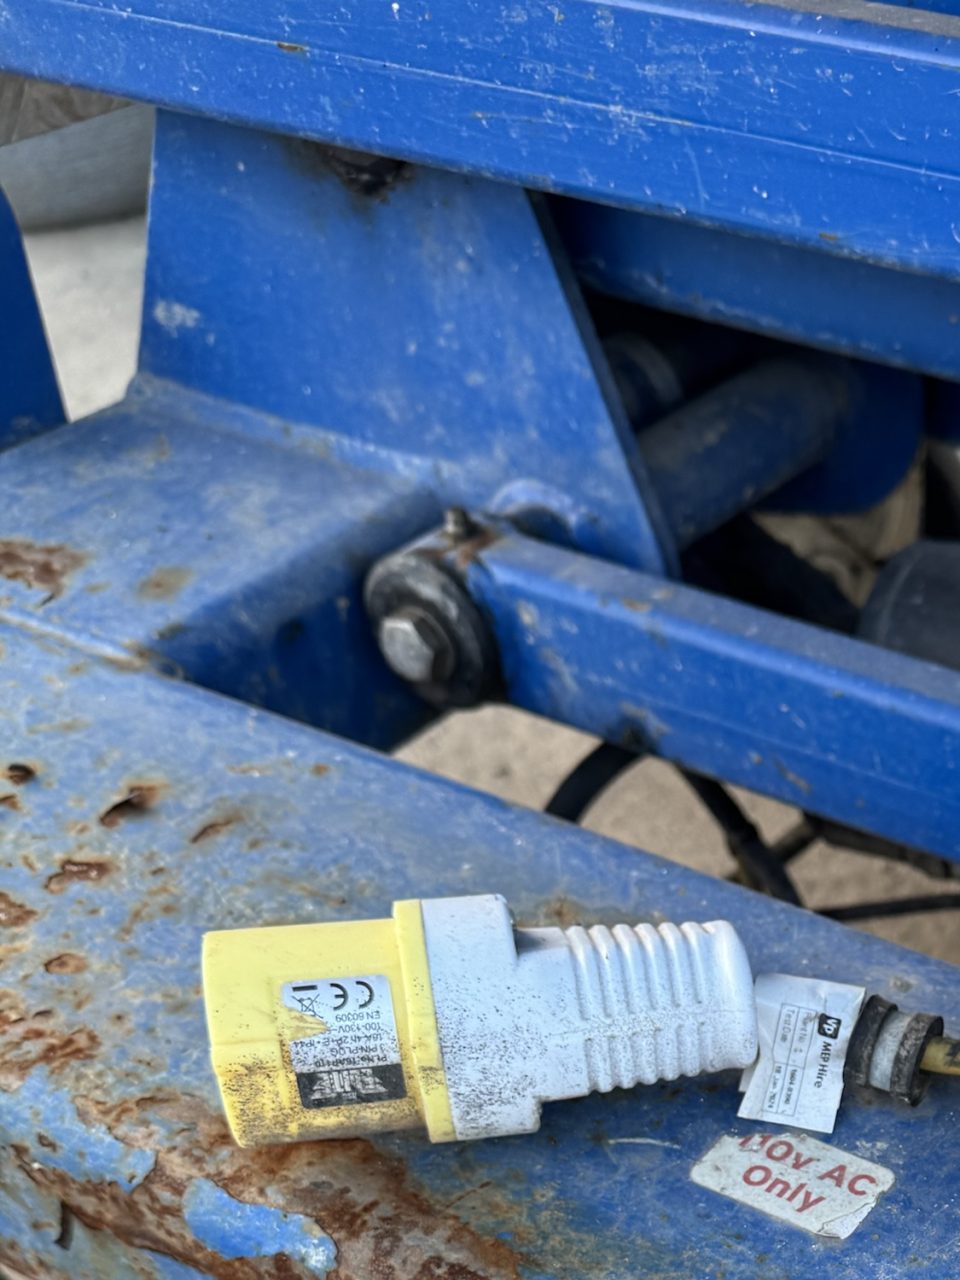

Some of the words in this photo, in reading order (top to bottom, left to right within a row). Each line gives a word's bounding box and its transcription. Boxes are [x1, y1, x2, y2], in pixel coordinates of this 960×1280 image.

[330, 980, 374, 1010] CE
[368, 1010, 381, 1020] EN
[820, 1041, 832, 1062] MEP
[814, 1064, 828, 1088] Hire
[742, 1165, 826, 1213] Only
[818, 1164, 877, 1196] AC
